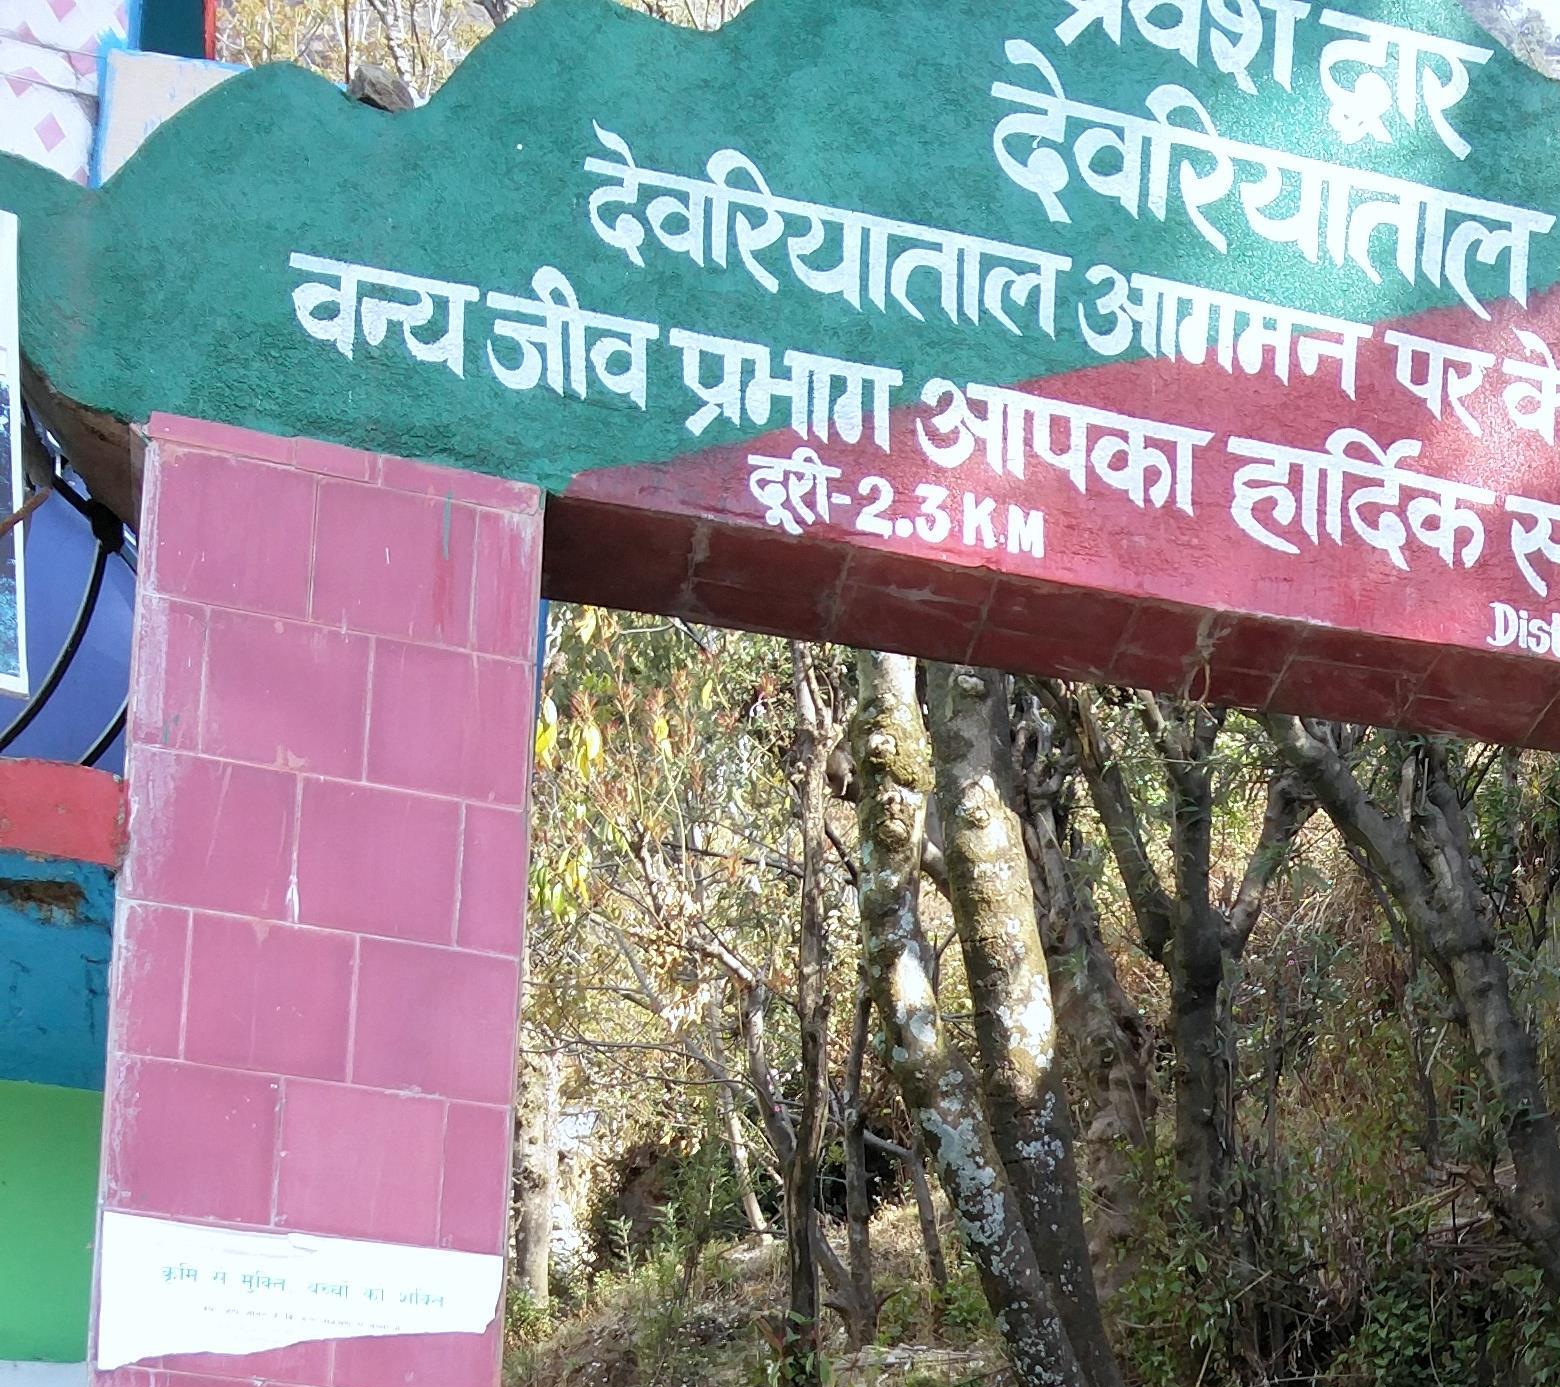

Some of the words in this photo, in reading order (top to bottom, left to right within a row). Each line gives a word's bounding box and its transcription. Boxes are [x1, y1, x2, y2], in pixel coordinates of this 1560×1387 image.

[991, 40, 1556, 321] देवरियाताल
[1318, 8, 1496, 161] द्वार
[289, 252, 479, 379] वन्य
[487, 266, 659, 410] जीव
[669, 328, 903, 454] प्रभाग
[916, 378, 1215, 518] आपका
[1228, 428, 1495, 570] हार्दिक
[584, 120, 1072, 339] देवरियाताल
[1079, 265, 1374, 401] आगमन
[1384, 330, 1496, 438] पर
